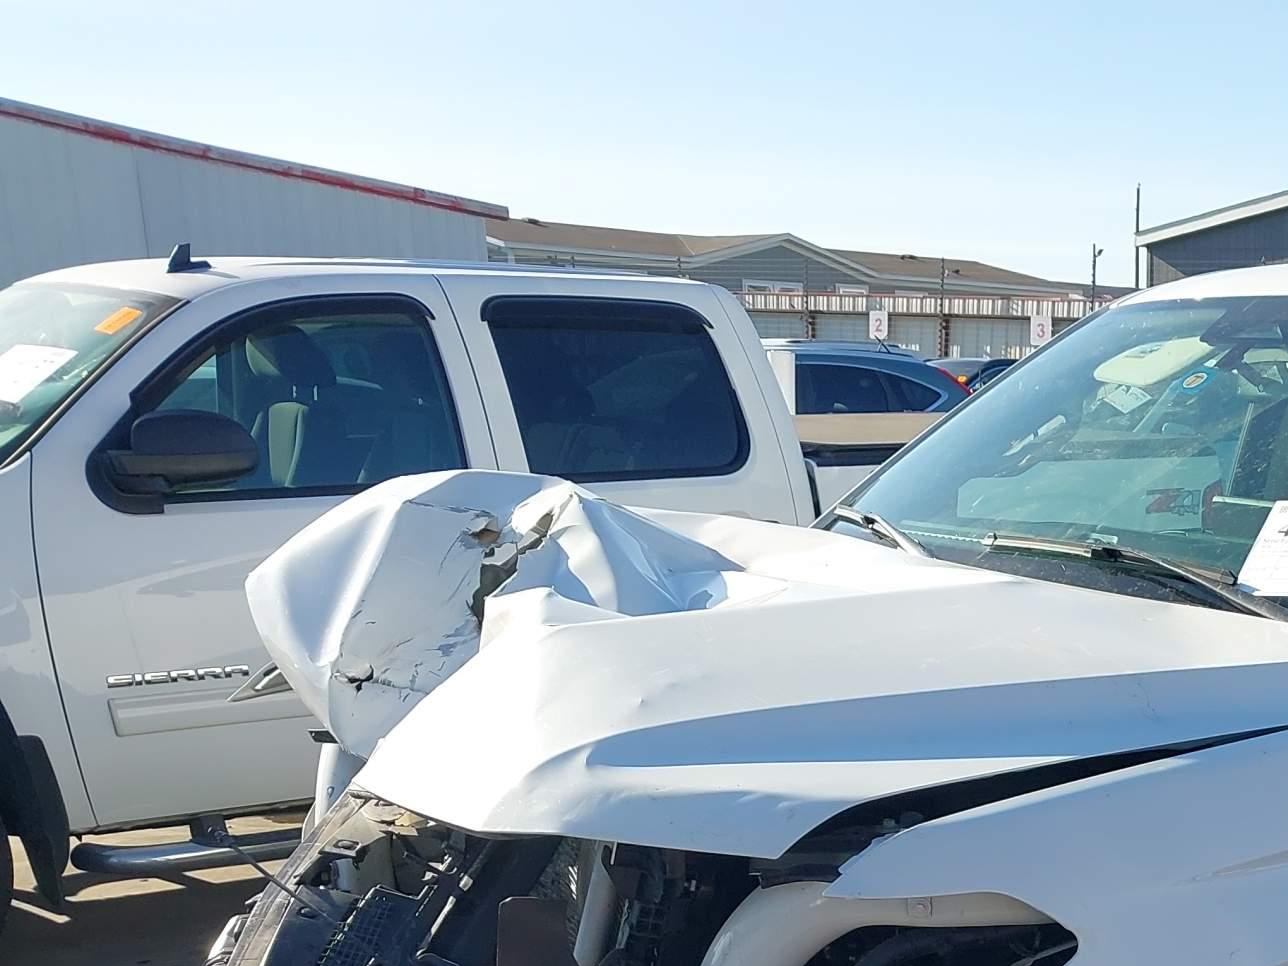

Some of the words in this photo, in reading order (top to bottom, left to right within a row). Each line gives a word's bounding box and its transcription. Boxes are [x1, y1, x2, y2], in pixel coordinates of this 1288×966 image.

[874, 318, 883, 332] 2
[1036, 323, 1046, 338] 3
[106, 664, 250, 689] SIERRA
